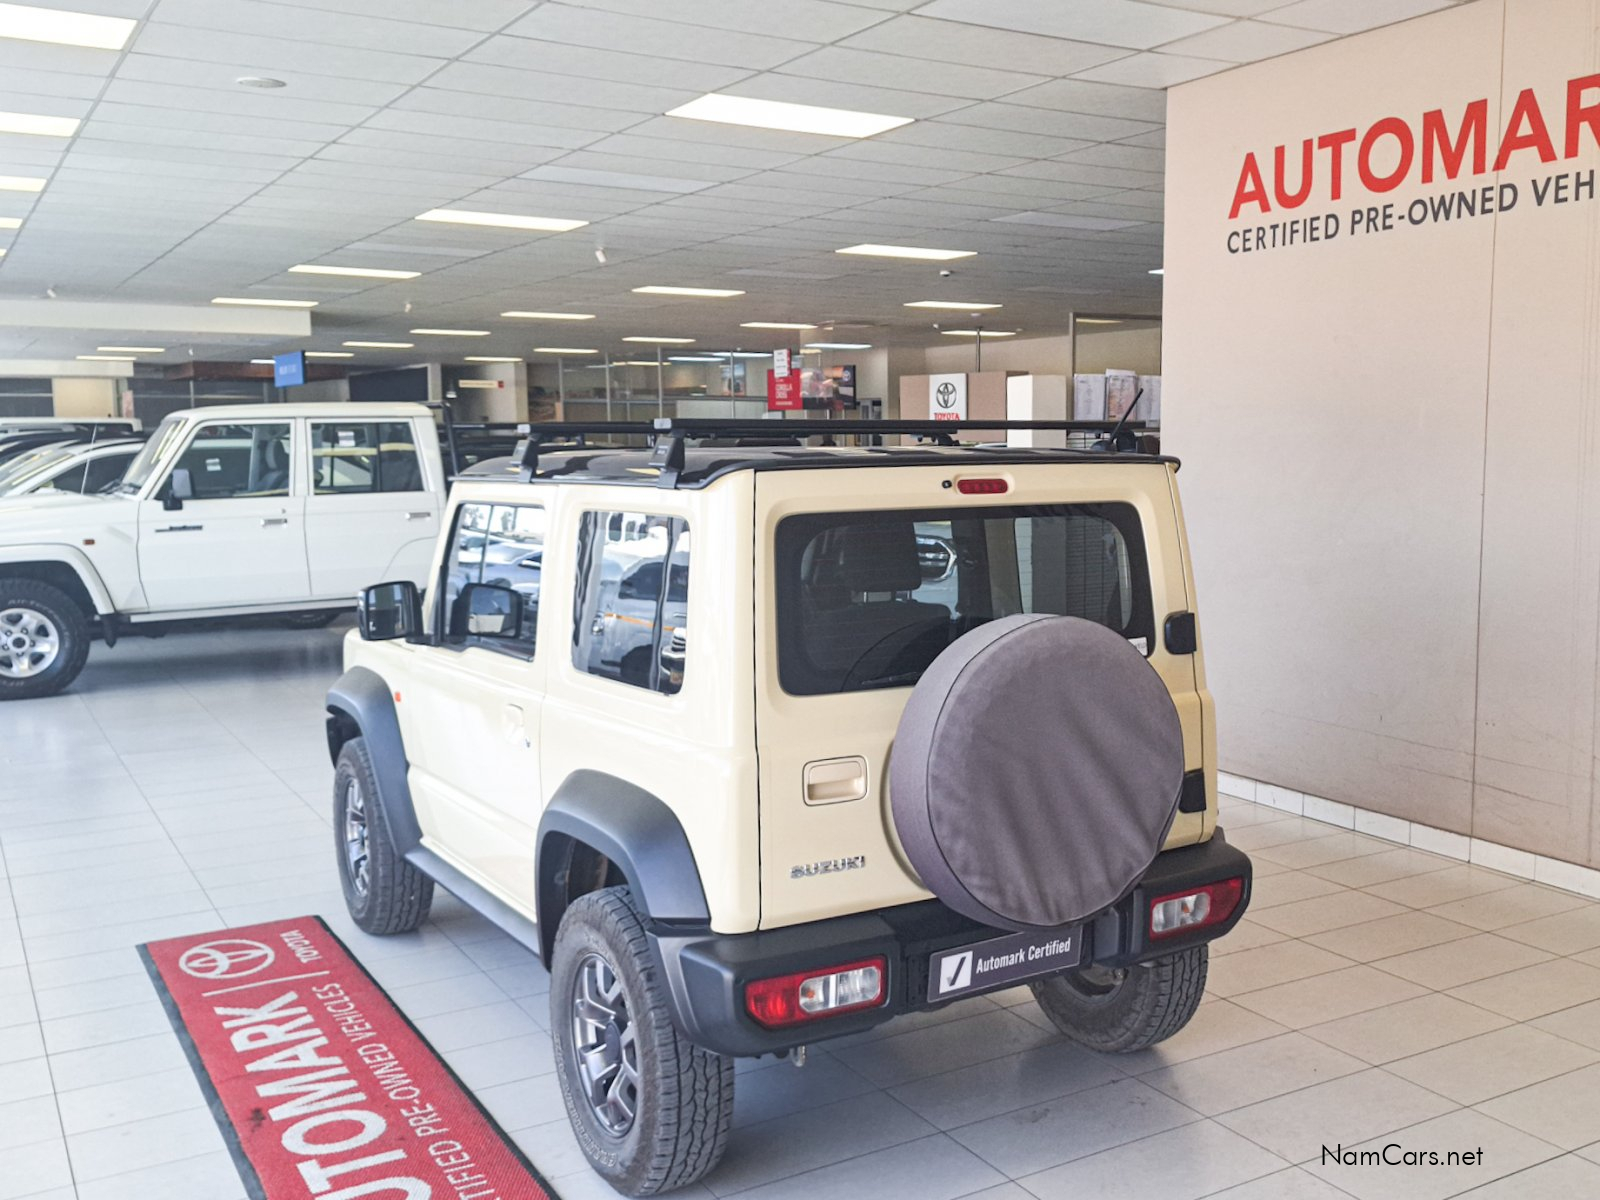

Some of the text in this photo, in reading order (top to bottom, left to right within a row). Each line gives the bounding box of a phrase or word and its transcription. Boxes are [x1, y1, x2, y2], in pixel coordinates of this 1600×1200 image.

[1228, 73, 1600, 219] AUTOMAR
[1227, 169, 1595, 254] CERTIFIED PRE-OWNED VEH
[934, 412, 960, 420] TOYOTA
[789, 855, 866, 879] SUZUKI
[280, 929, 322, 963] TOYOTA
[976, 937, 1071, 974] Automark Certified
[311, 983, 501, 1200] TIFIED PRE-OWNED VEHICLES
